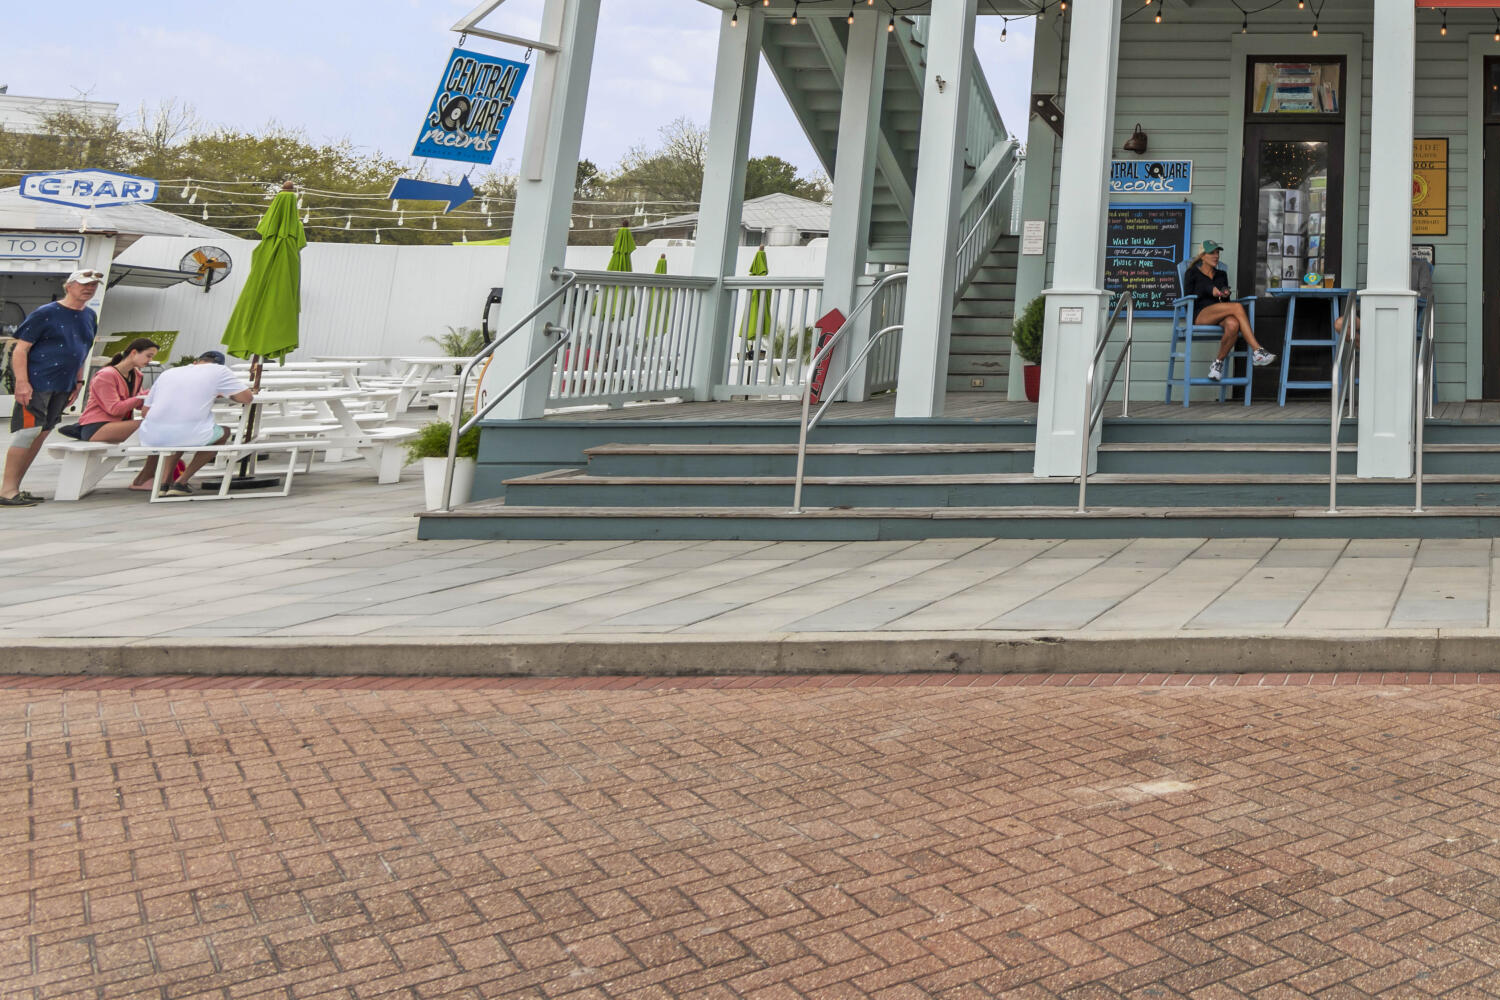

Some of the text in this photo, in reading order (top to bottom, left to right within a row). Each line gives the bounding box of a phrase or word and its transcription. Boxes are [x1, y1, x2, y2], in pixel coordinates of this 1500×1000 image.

[445, 56, 520, 101] CENTRAL
[428, 91, 509, 135] SQUARE
[421, 129, 497, 151] records
[1144, 163, 1188, 179] SQUARE
[8, 239, 78, 253] TO GO
